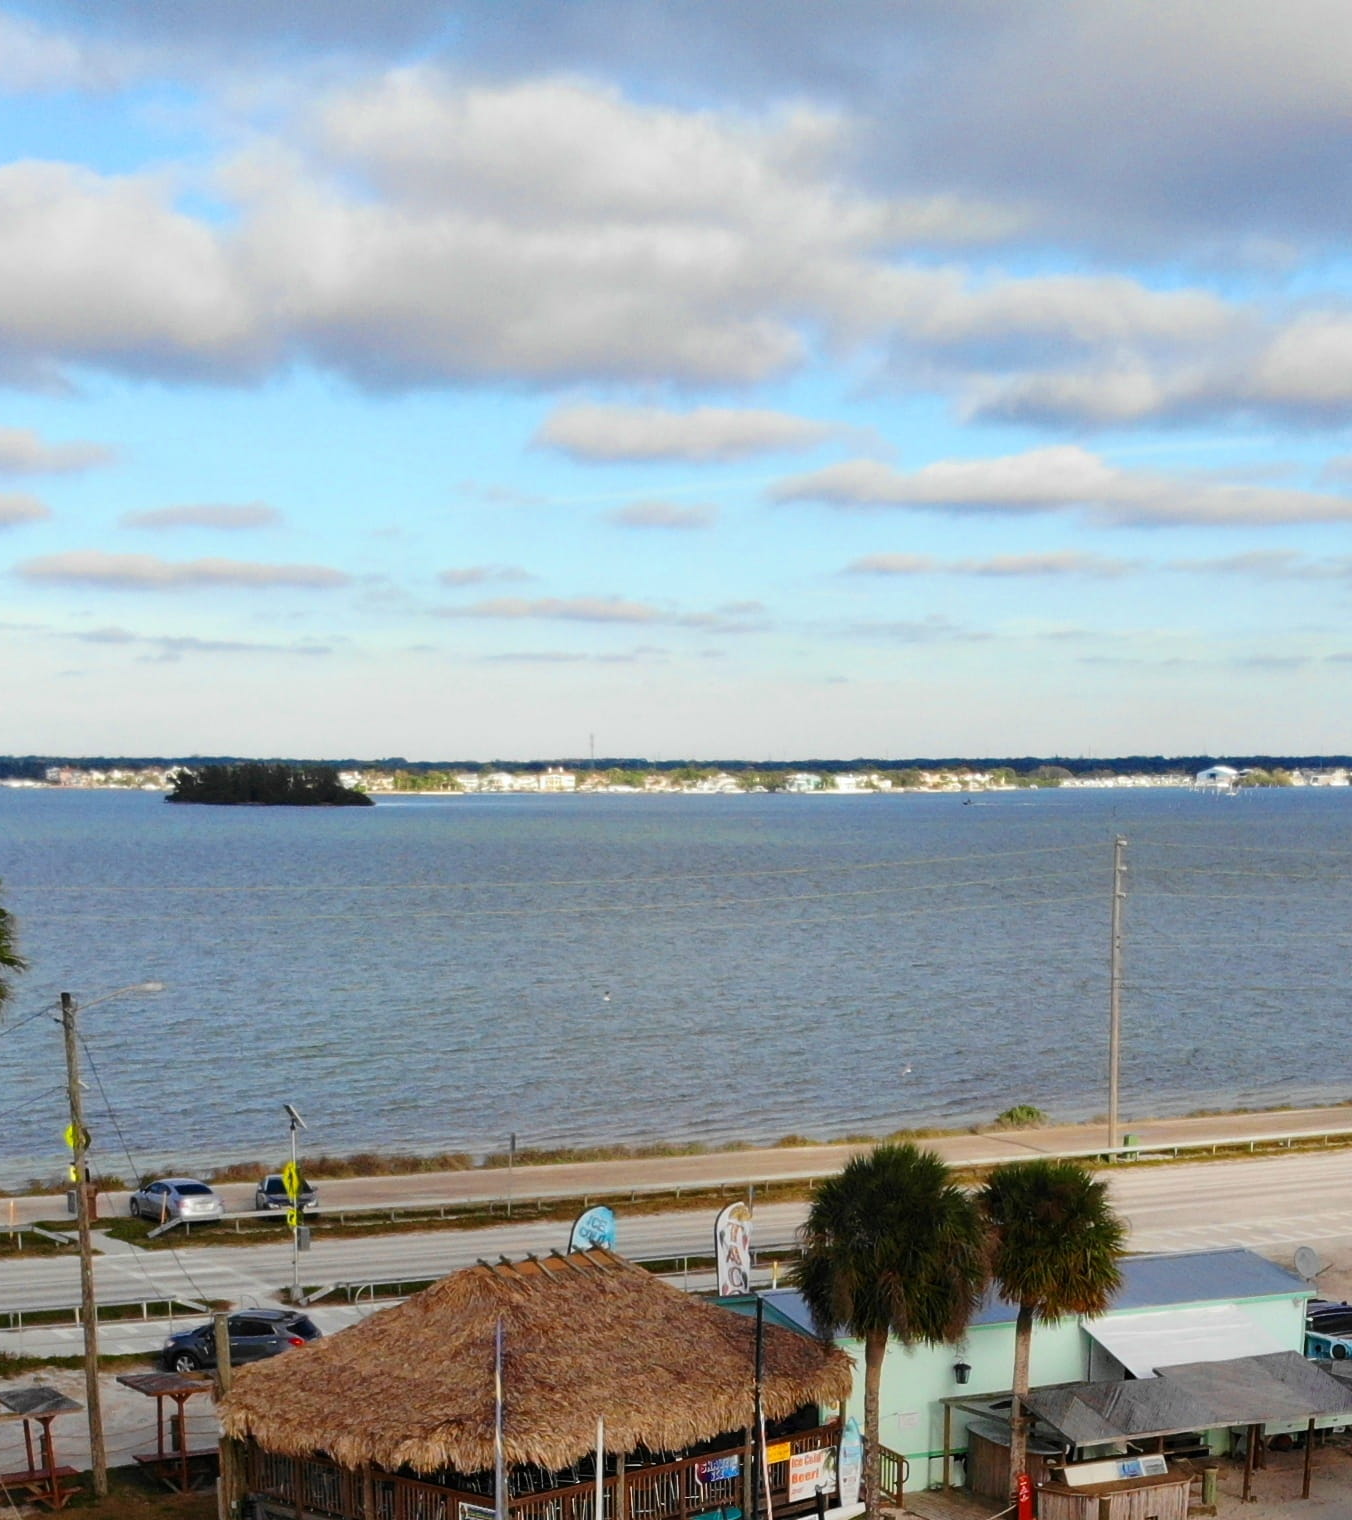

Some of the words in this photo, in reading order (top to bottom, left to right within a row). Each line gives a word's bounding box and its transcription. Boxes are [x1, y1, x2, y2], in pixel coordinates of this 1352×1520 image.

[587, 1215, 608, 1234] ICE
[791, 1457, 803, 1468] Ice
[791, 1468, 819, 1484] Beer!
